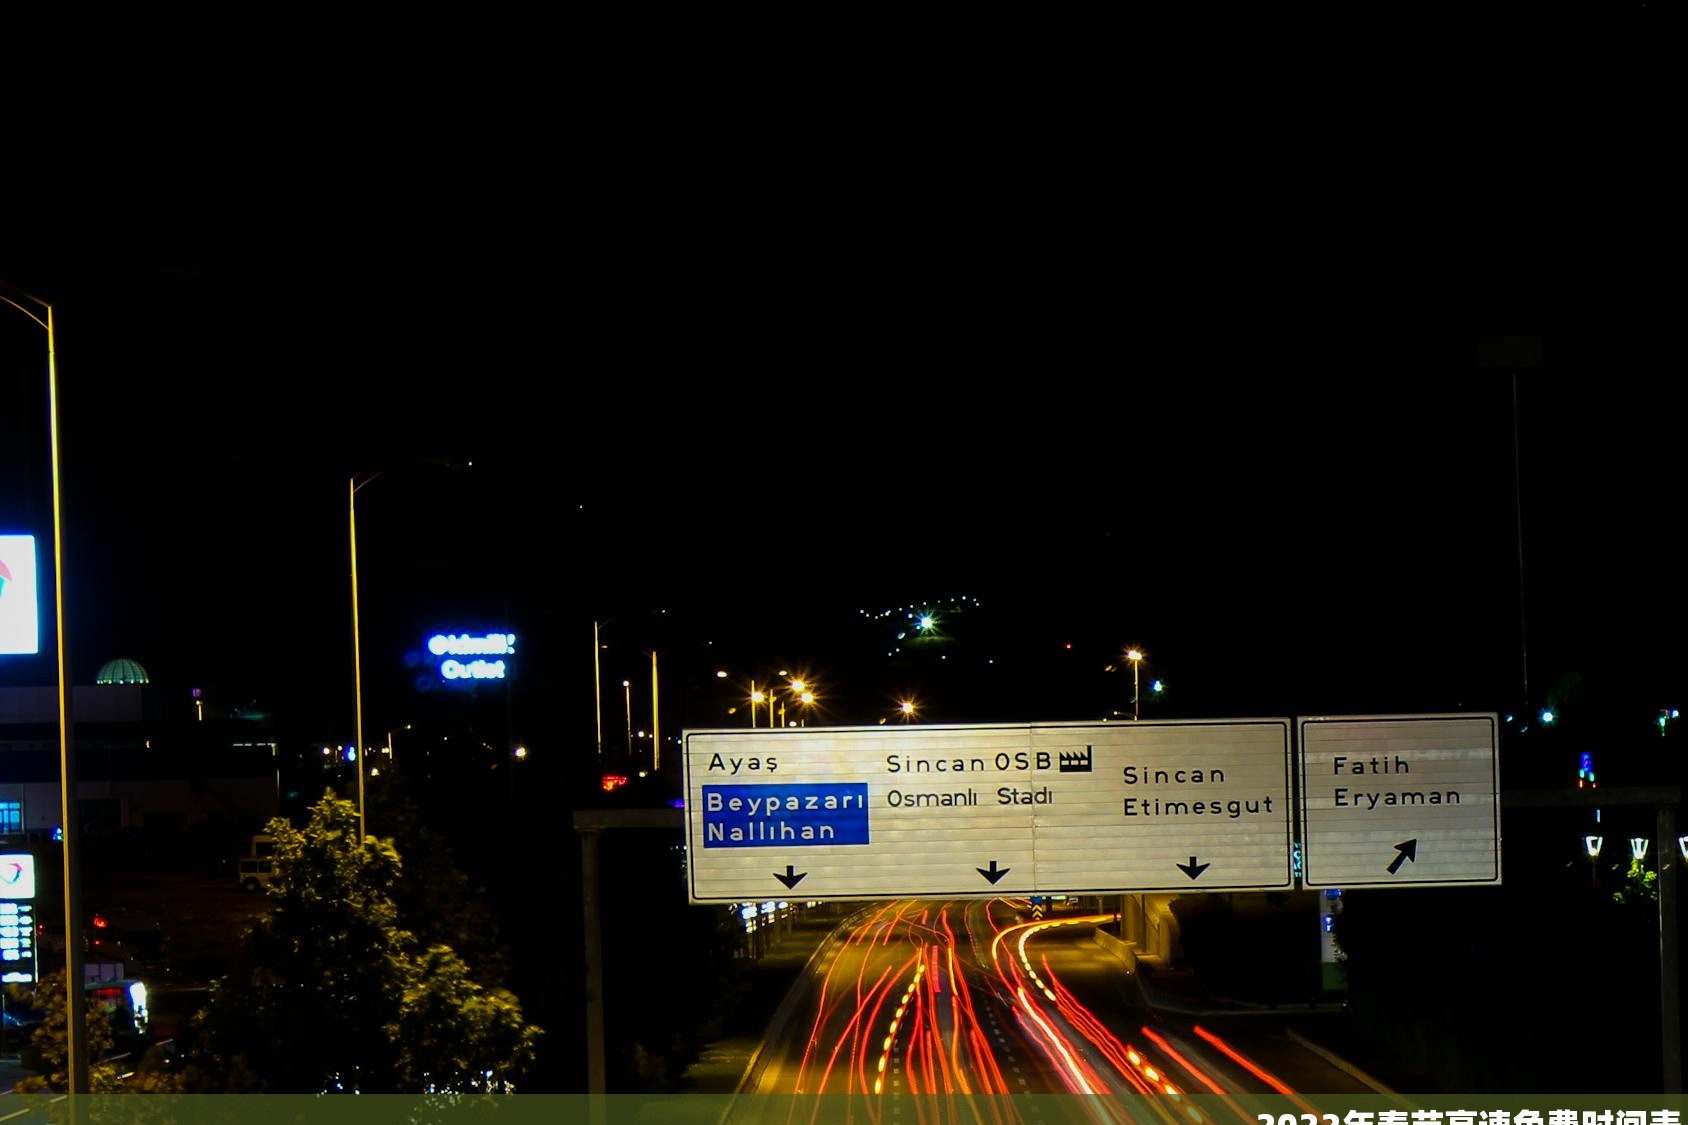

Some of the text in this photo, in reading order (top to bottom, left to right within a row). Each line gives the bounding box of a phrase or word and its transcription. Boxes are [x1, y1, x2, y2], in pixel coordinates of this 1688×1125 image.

[708, 752, 778, 775] Ayaş
[886, 752, 1052, 773] Sincan OSB
[1333, 755, 1410, 776] Fatih
[1123, 766, 1226, 785] Sincan
[707, 792, 864, 818] Beypazarı
[887, 786, 1053, 808] Osmanlı Stadı
[1124, 795, 1274, 819] Etimesgut
[1334, 787, 1461, 811] Eryaman
[708, 822, 835, 842] Nallıhan
